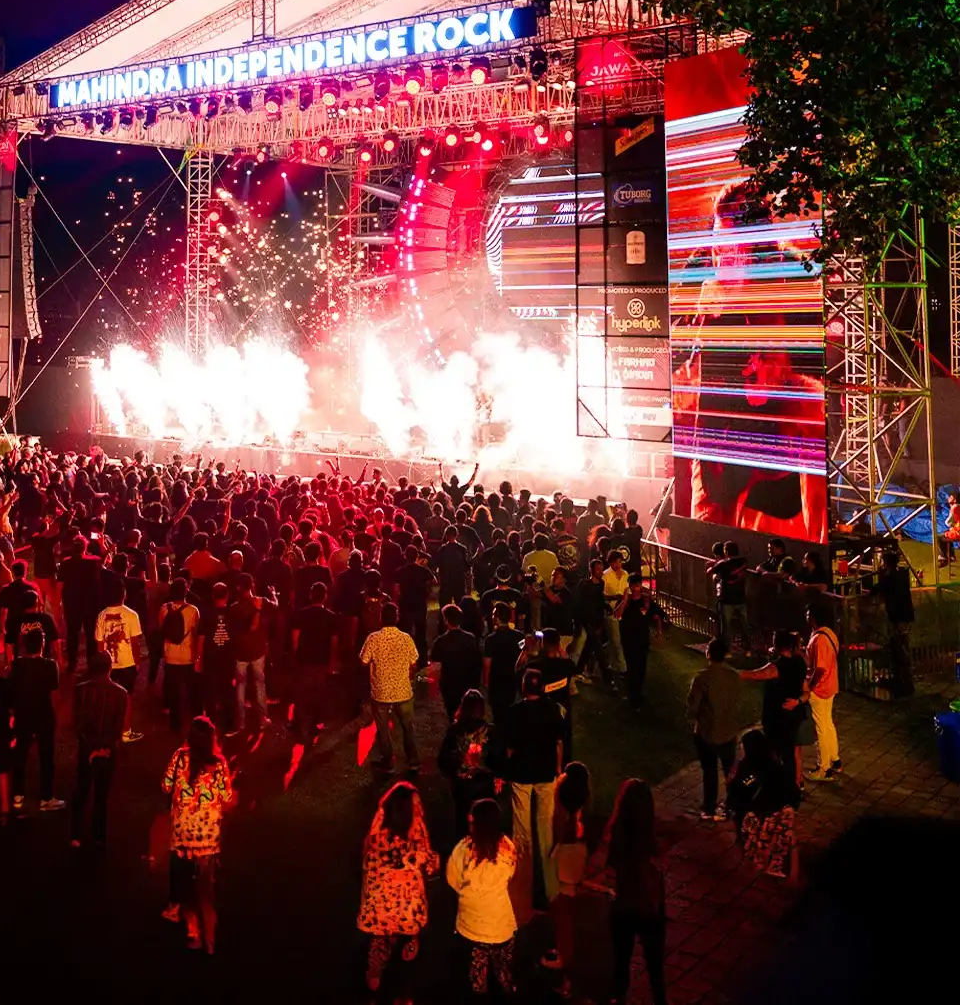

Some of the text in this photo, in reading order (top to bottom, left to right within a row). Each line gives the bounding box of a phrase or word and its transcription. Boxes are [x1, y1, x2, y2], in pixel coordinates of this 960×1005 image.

[57, 8, 516, 108] MAHINDRA INDEPENDENCE ROCK
[590, 63, 631, 77] JAWA
[619, 189, 652, 200] TUBORG
[611, 315, 661, 333] hyperlink
